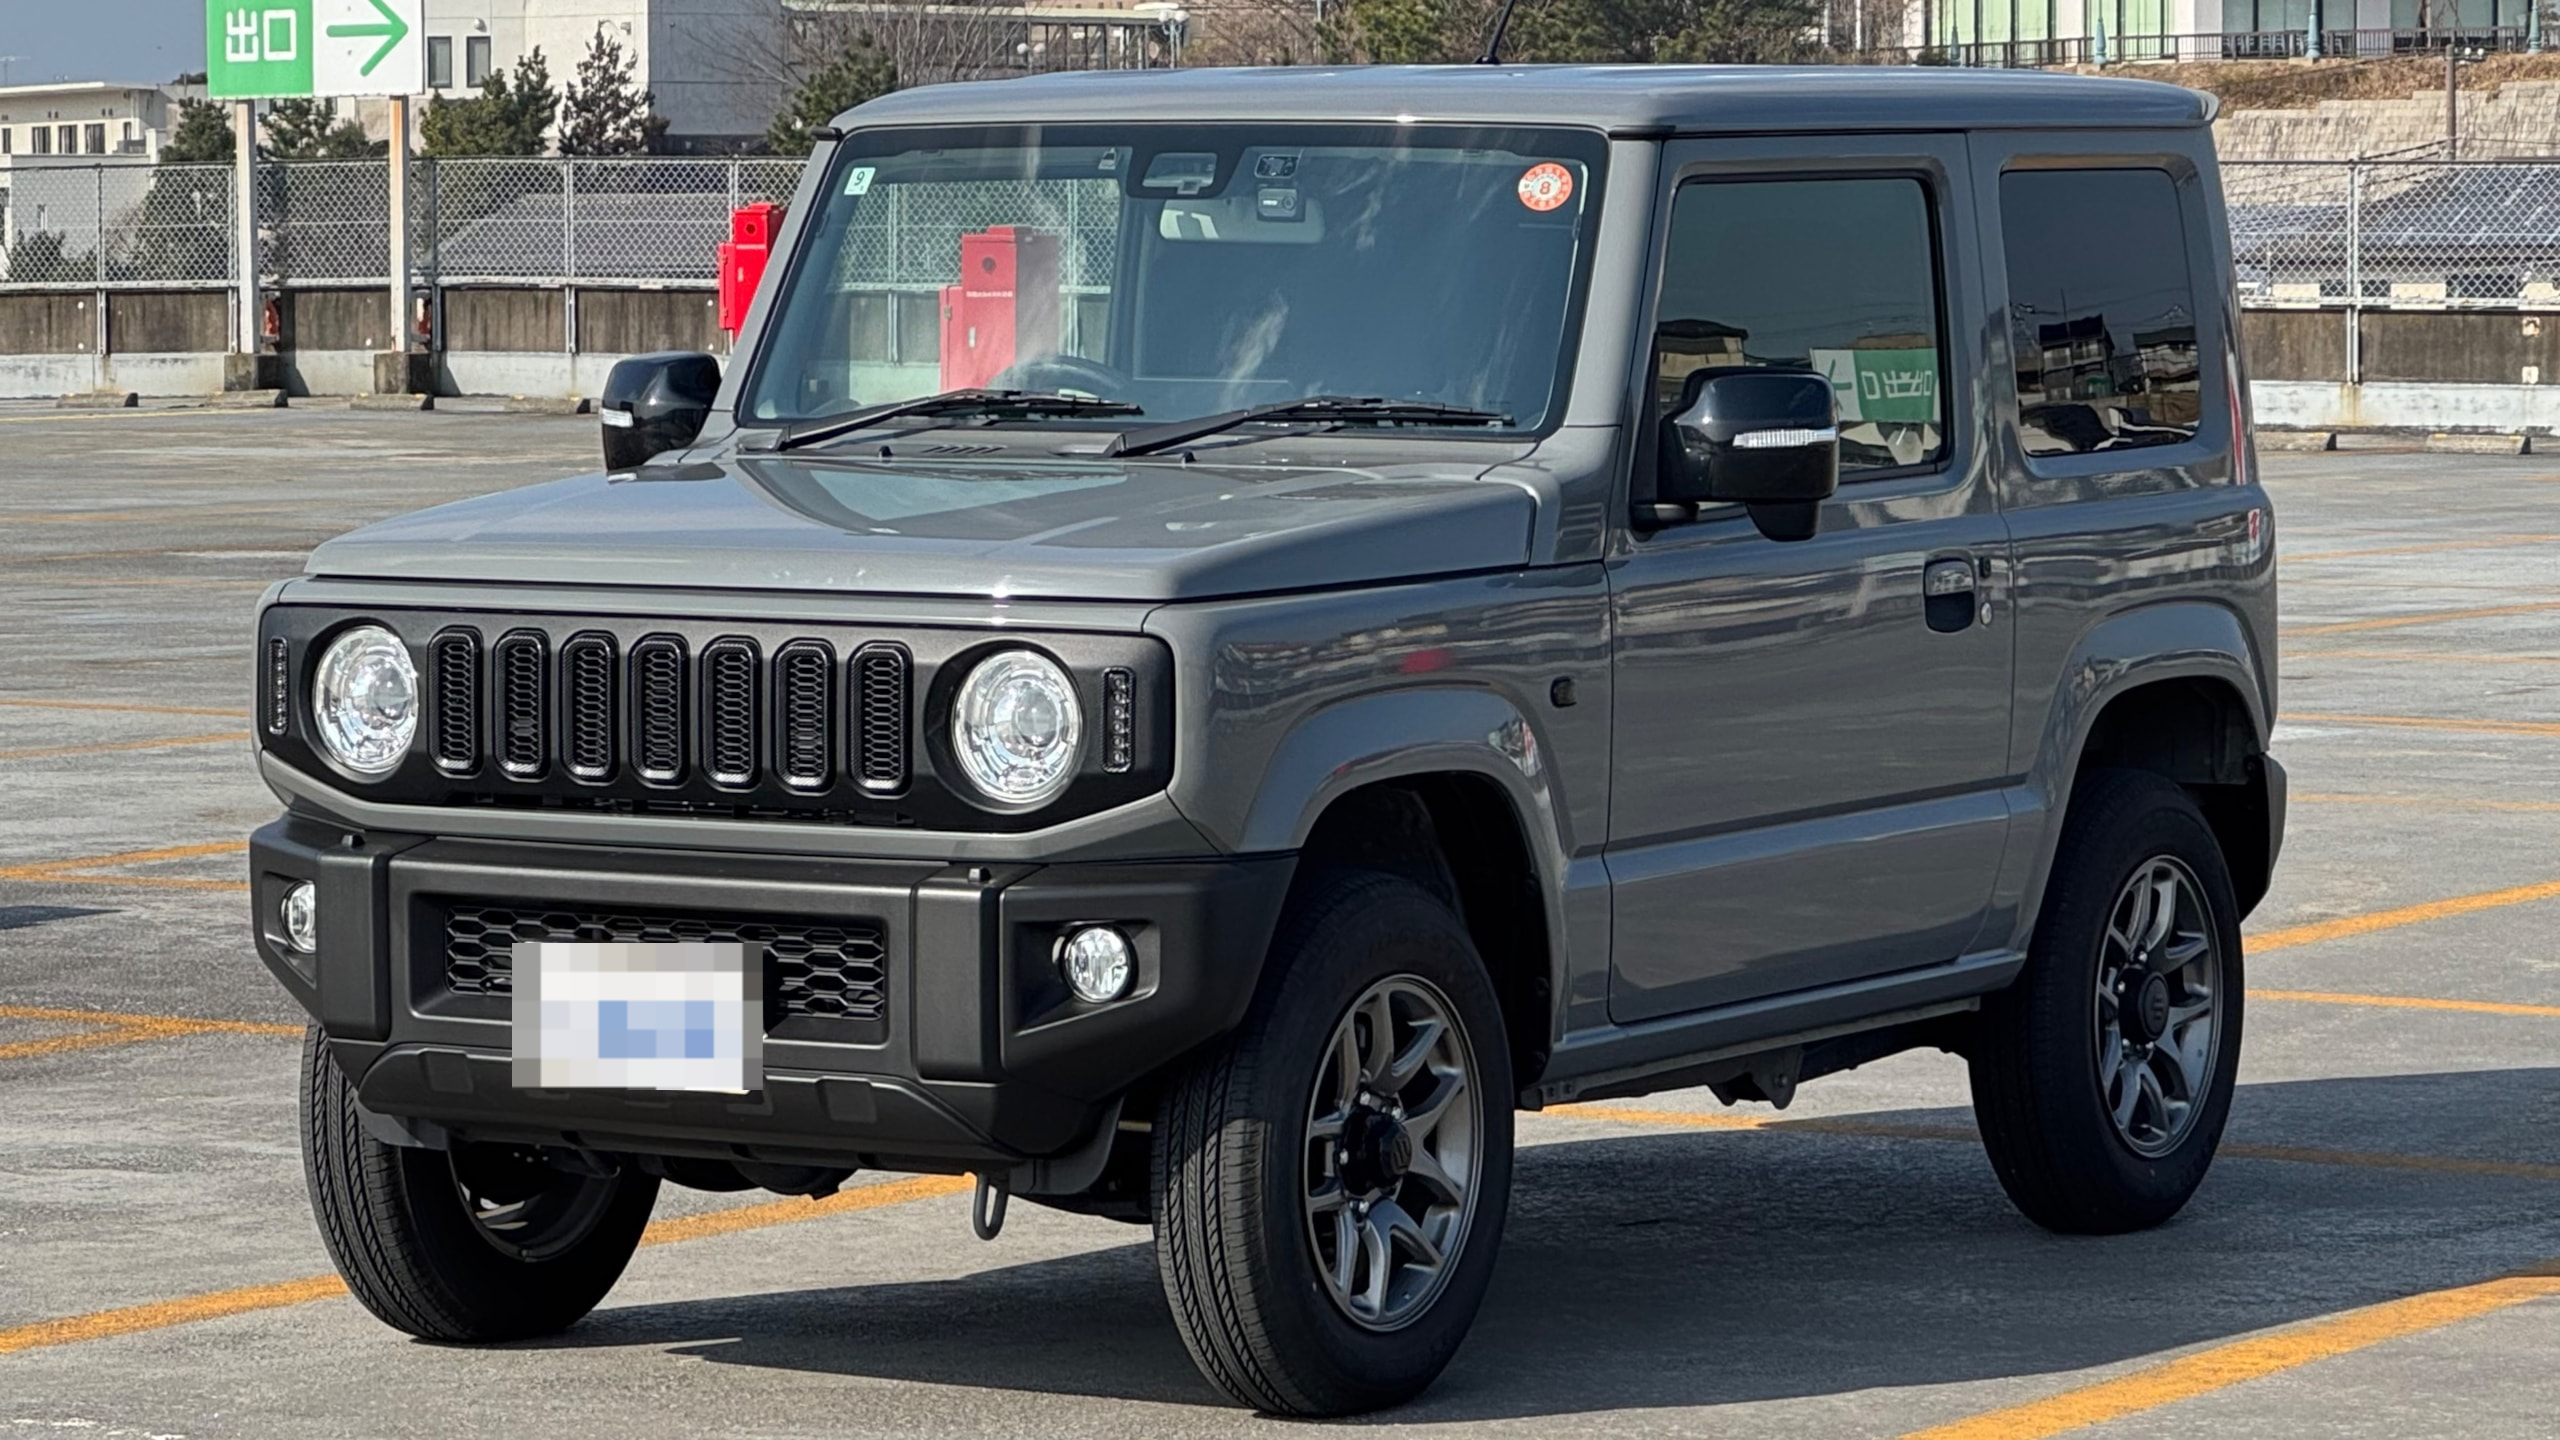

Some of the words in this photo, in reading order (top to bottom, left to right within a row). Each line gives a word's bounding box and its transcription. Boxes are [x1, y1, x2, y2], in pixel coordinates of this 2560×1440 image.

[225, 8, 297, 62] 出口
[854, 171, 865, 186] 9
[1540, 181, 1551, 195] 8
